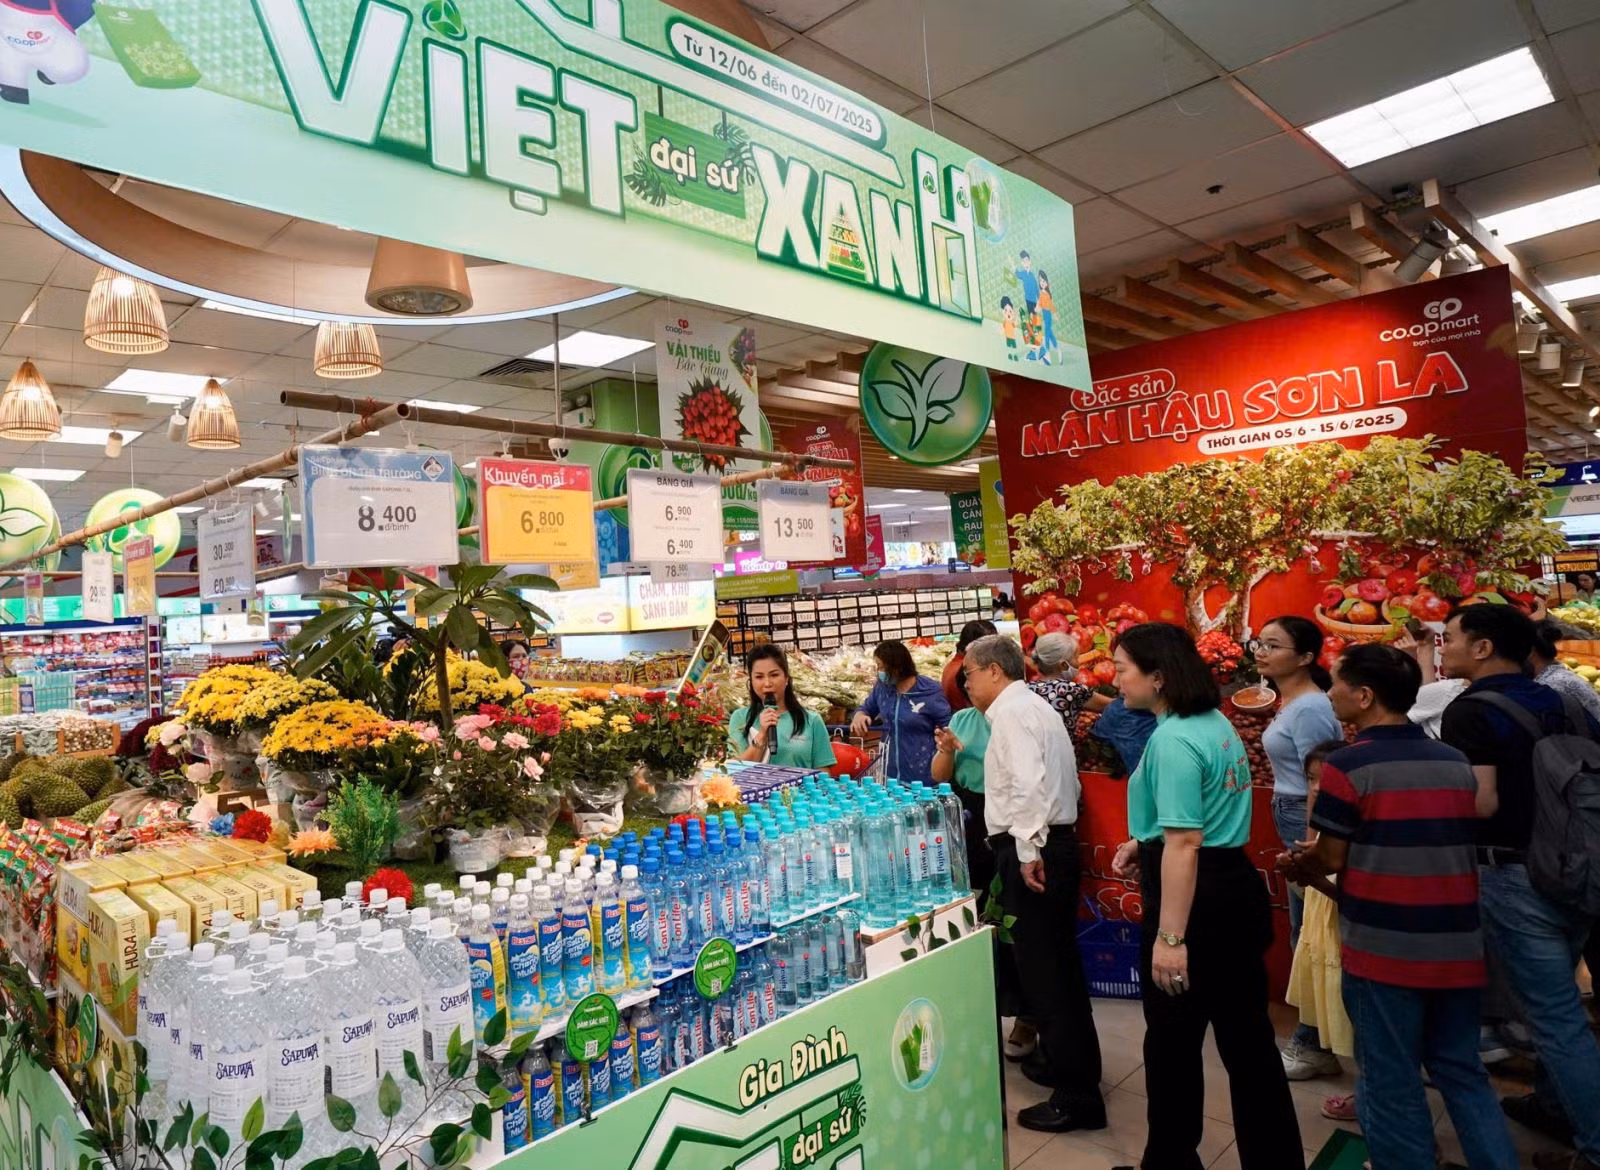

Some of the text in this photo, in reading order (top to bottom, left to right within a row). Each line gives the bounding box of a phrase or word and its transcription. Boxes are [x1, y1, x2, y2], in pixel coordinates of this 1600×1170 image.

[683, 34, 873, 134] Từ 12/06 đến 02/07/2025
[649, 136, 740, 194] đại sứ
[752, 148, 983, 325] XANH
[1021, 350, 1469, 458] MẬN HẬU SƠN LA
[1080, 376, 1166, 407] Đặc sản
[1206, 433, 1236, 449] THỜI
[1238, 430, 1271, 444] GIAN
[1274, 426, 1307, 439] 05/6
[1319, 413, 1395, 433] 15/6/2025
[520, 510, 565, 534] 6.800
[665, 505, 692, 521] 6.900
[774, 517, 814, 538] 13.500
[124, 934, 140, 971] HURA
[739, 1025, 848, 1108] Gia Đình
[791, 1105, 853, 1165] đại sứ
